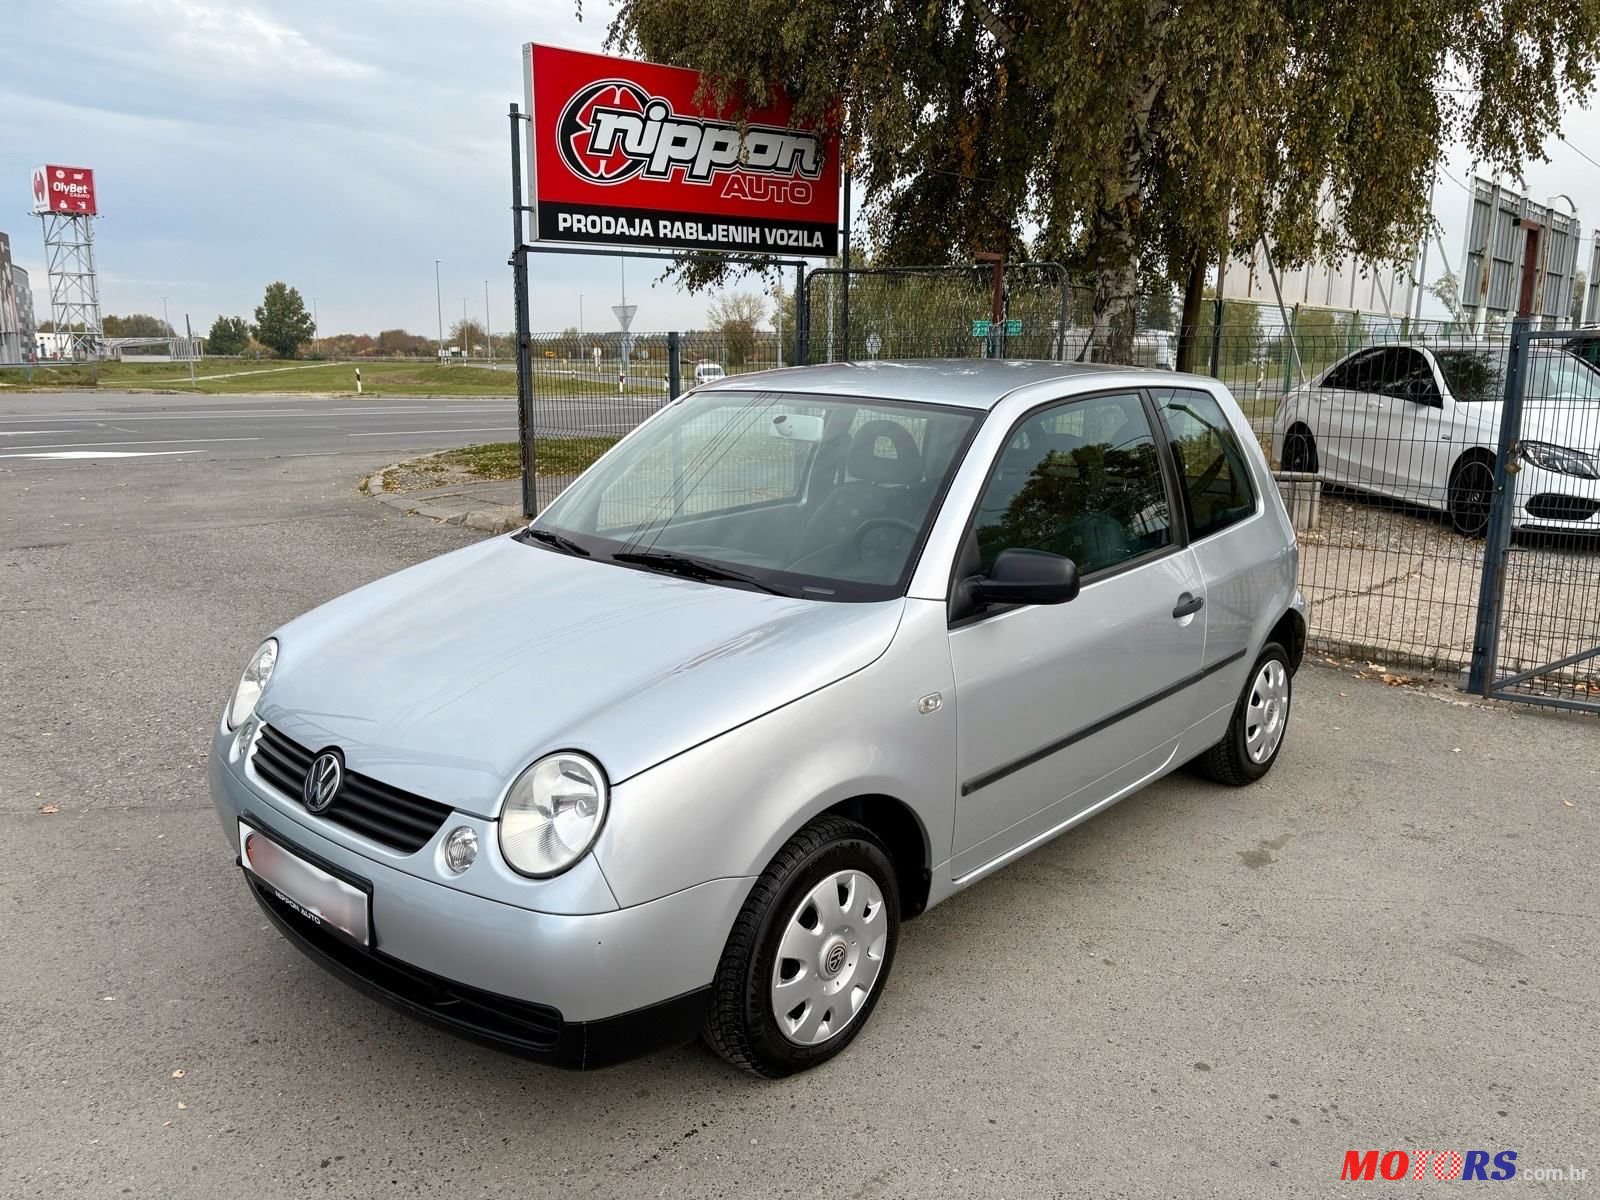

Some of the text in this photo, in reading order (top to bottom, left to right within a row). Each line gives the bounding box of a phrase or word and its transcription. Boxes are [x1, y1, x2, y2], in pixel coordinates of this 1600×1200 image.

[53, 182, 88, 194] OlyBet
[721, 174, 813, 205] AUTO
[558, 212, 824, 248] PRODAJA RABLJENIH VOZILA
[275, 890, 321, 925] NIPPON AUTO
